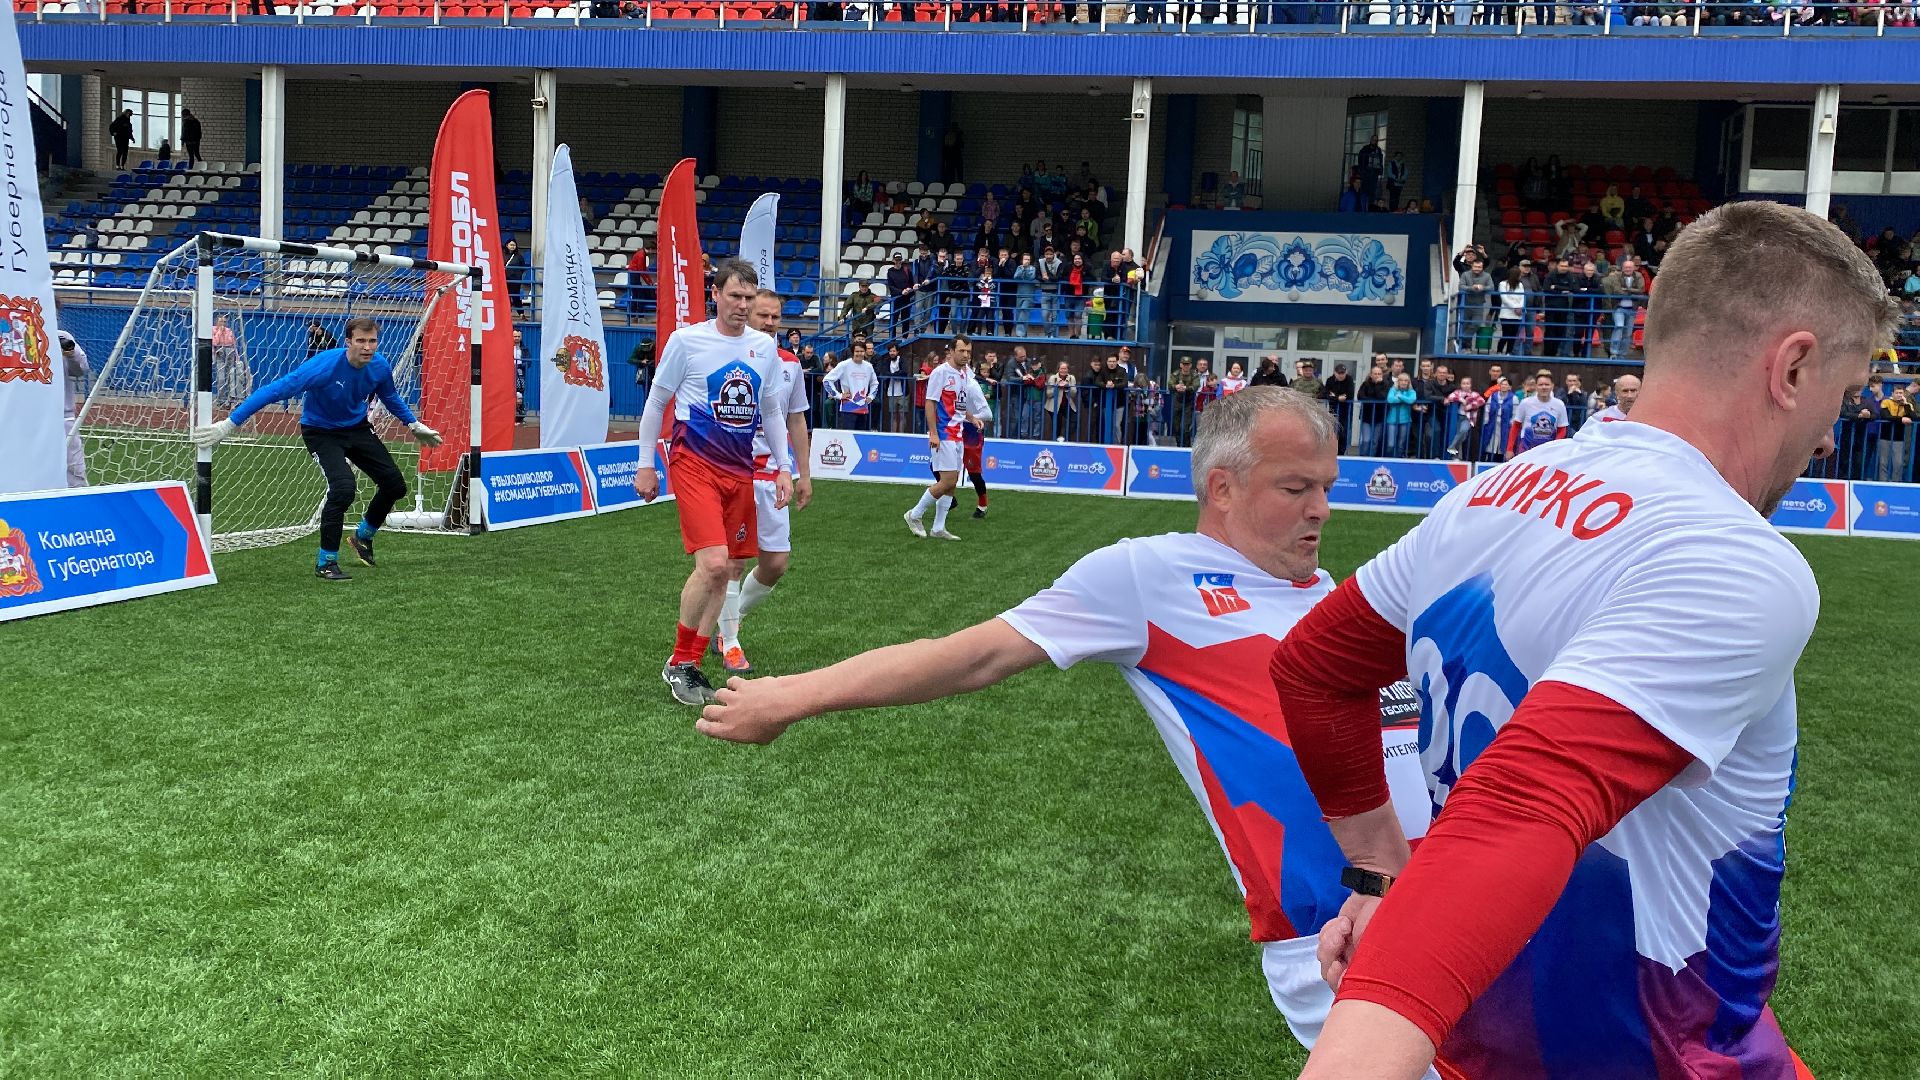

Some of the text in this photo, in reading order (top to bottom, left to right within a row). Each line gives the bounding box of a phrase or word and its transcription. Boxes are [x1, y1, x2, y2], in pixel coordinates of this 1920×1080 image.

[677, 253, 690, 326] ПОРТ
[597, 460, 639, 476] #ВЫХОДИВОДВ
[494, 482, 580, 503] #КОМАНДАГУБЕРНАТОРА
[1466, 462, 1634, 541] ШИРКО
[38, 528, 116, 550] Команда
[47, 550, 155, 581] Губернатора
